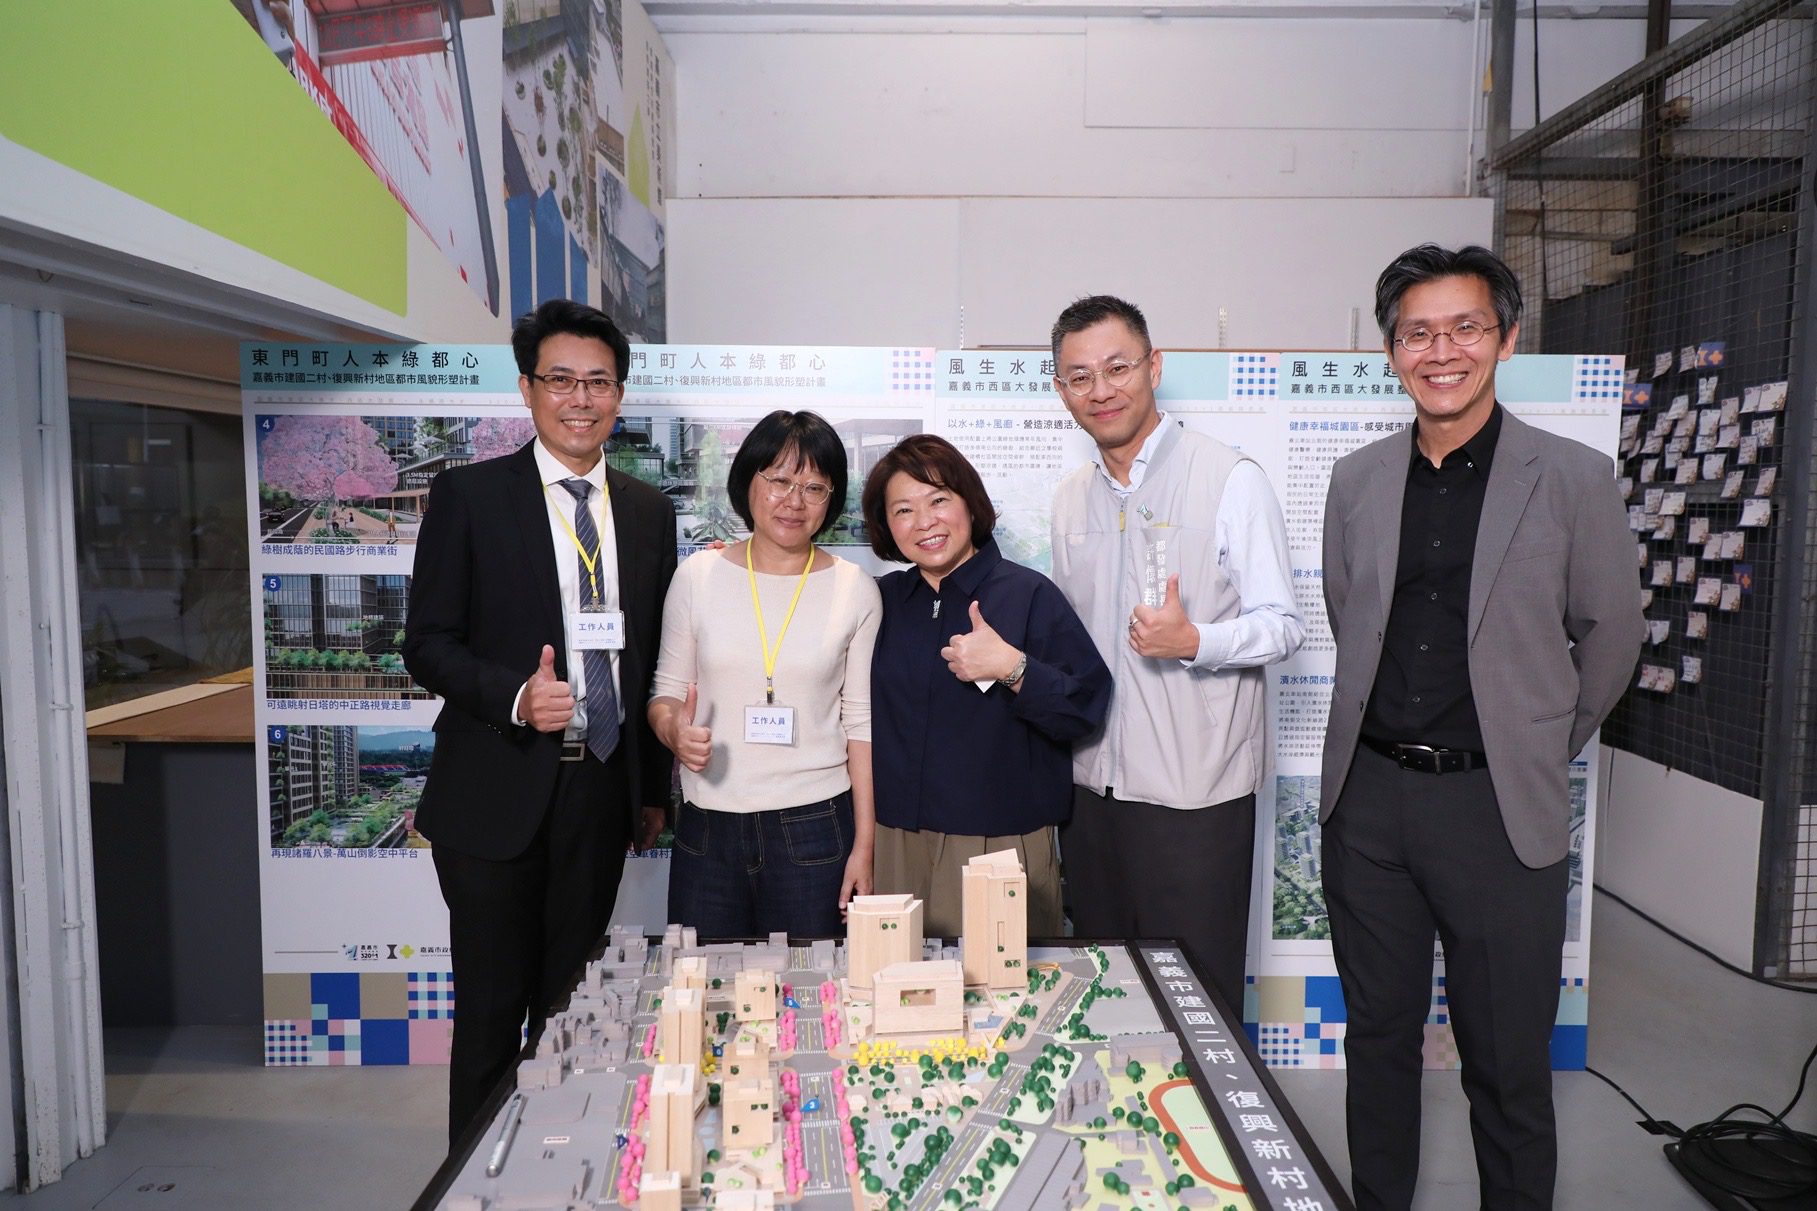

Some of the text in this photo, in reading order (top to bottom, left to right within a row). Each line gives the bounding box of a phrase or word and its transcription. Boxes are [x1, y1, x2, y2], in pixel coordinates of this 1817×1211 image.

[252, 348, 479, 369] 東門町人本綠都心
[629, 351, 826, 371] 門町人本綠都心
[949, 358, 1056, 376] 風生水起
[949, 381, 1059, 392] 嘉義市西區大發展
[262, 420, 270, 429] 4
[261, 544, 398, 556] 綠樹成蔭的民國路步行商業街
[269, 579, 277, 588] 5
[578, 623, 615, 631] 工作人員
[751, 717, 786, 725] 工作人員
[274, 730, 281, 739] 6
[420, 946, 452, 954] 嘉義市政
